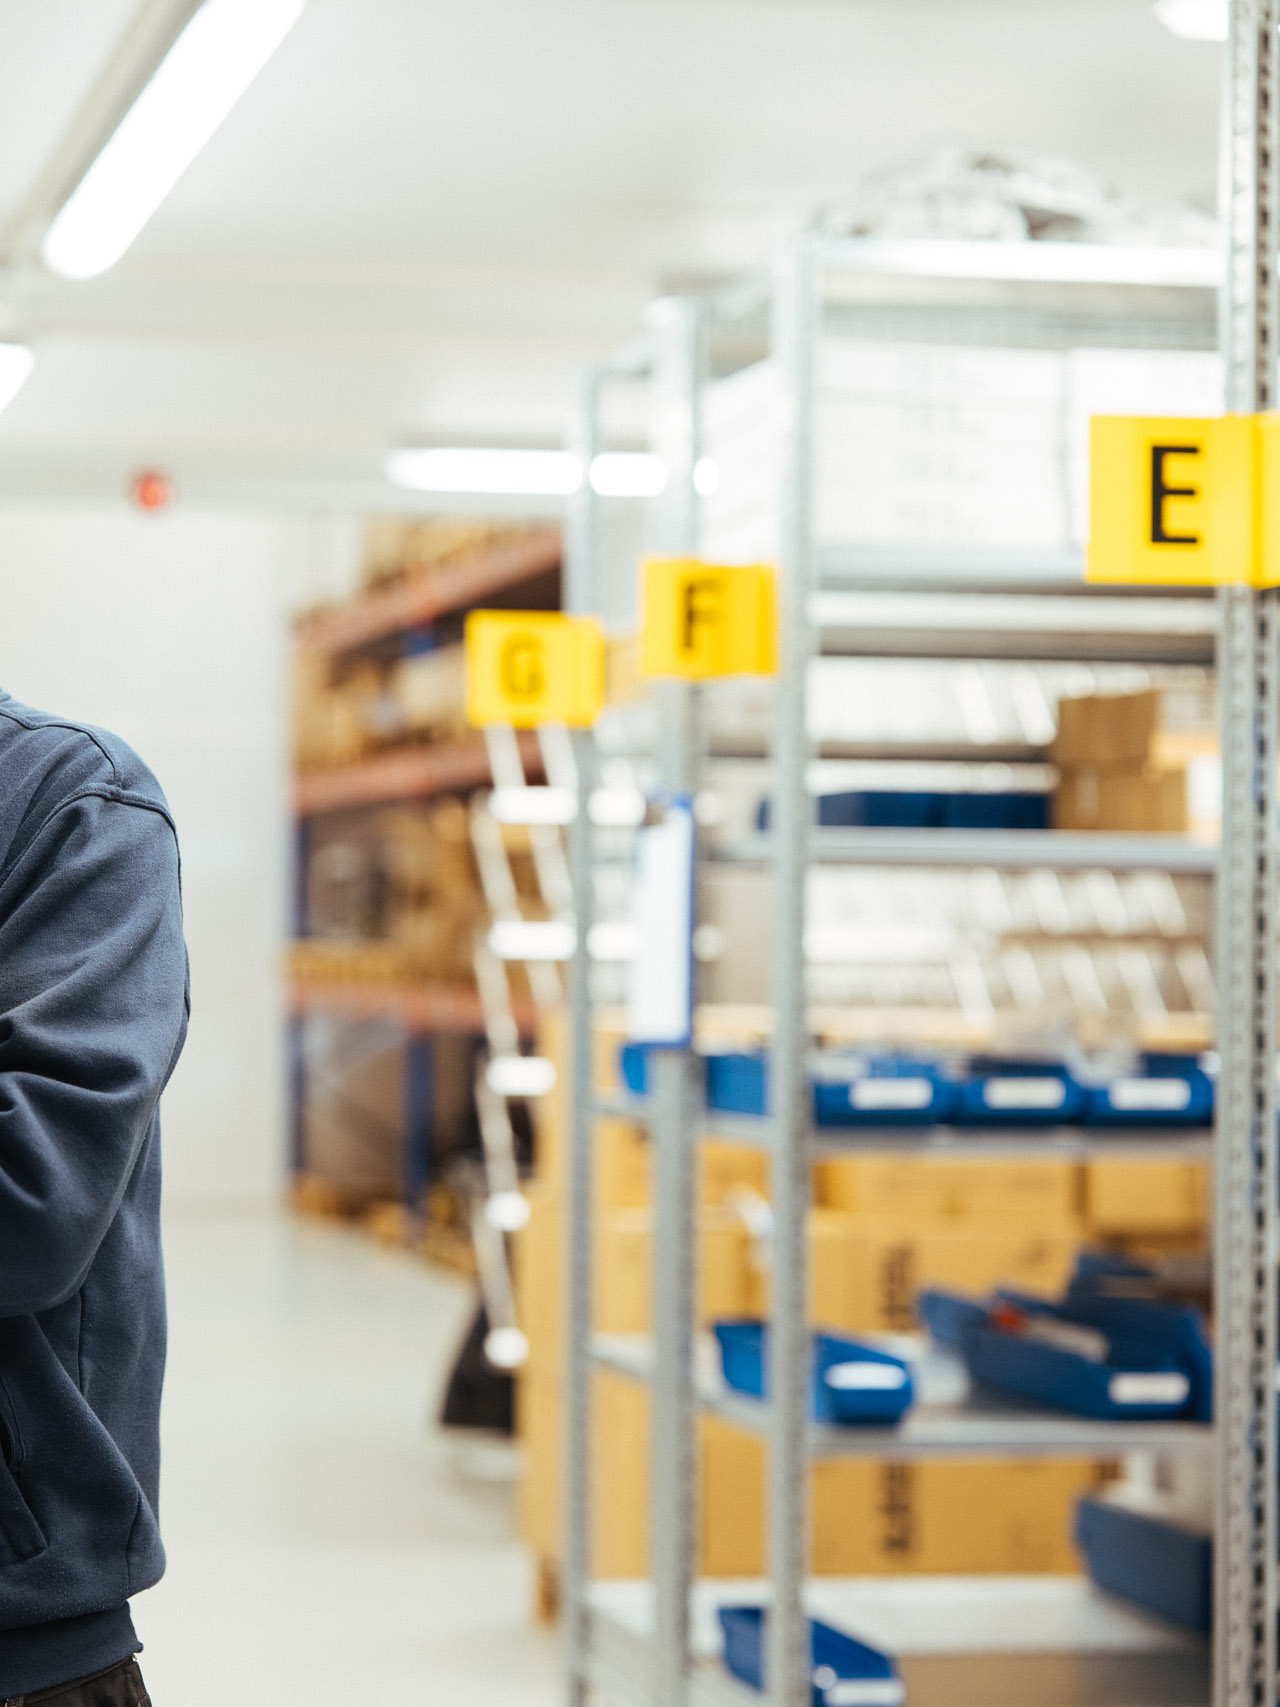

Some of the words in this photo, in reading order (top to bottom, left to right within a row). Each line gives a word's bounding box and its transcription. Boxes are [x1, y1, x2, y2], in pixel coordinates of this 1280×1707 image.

[1151, 445, 1199, 543] E
[682, 578, 728, 650] F
[500, 632, 544, 704] G
